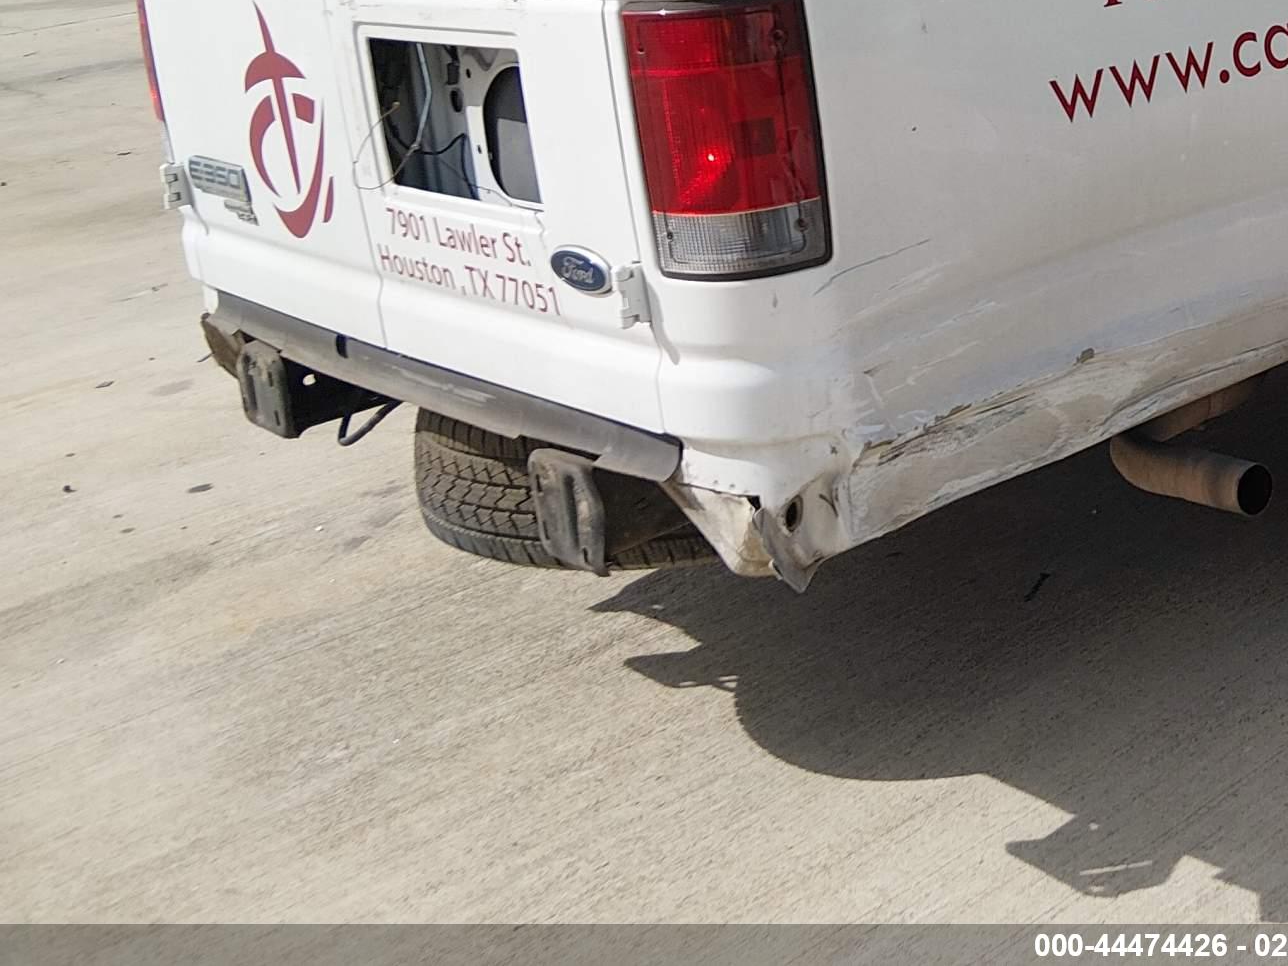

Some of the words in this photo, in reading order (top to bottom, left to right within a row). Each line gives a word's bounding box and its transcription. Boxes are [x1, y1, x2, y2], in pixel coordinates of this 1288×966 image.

[386, 207, 431, 243] 7901
[433, 217, 498, 260] Lawler
[502, 231, 532, 267] St.
[376, 243, 457, 290] Houston
[496, 273, 562, 317] 77051
[560, 255, 596, 285] Ford
